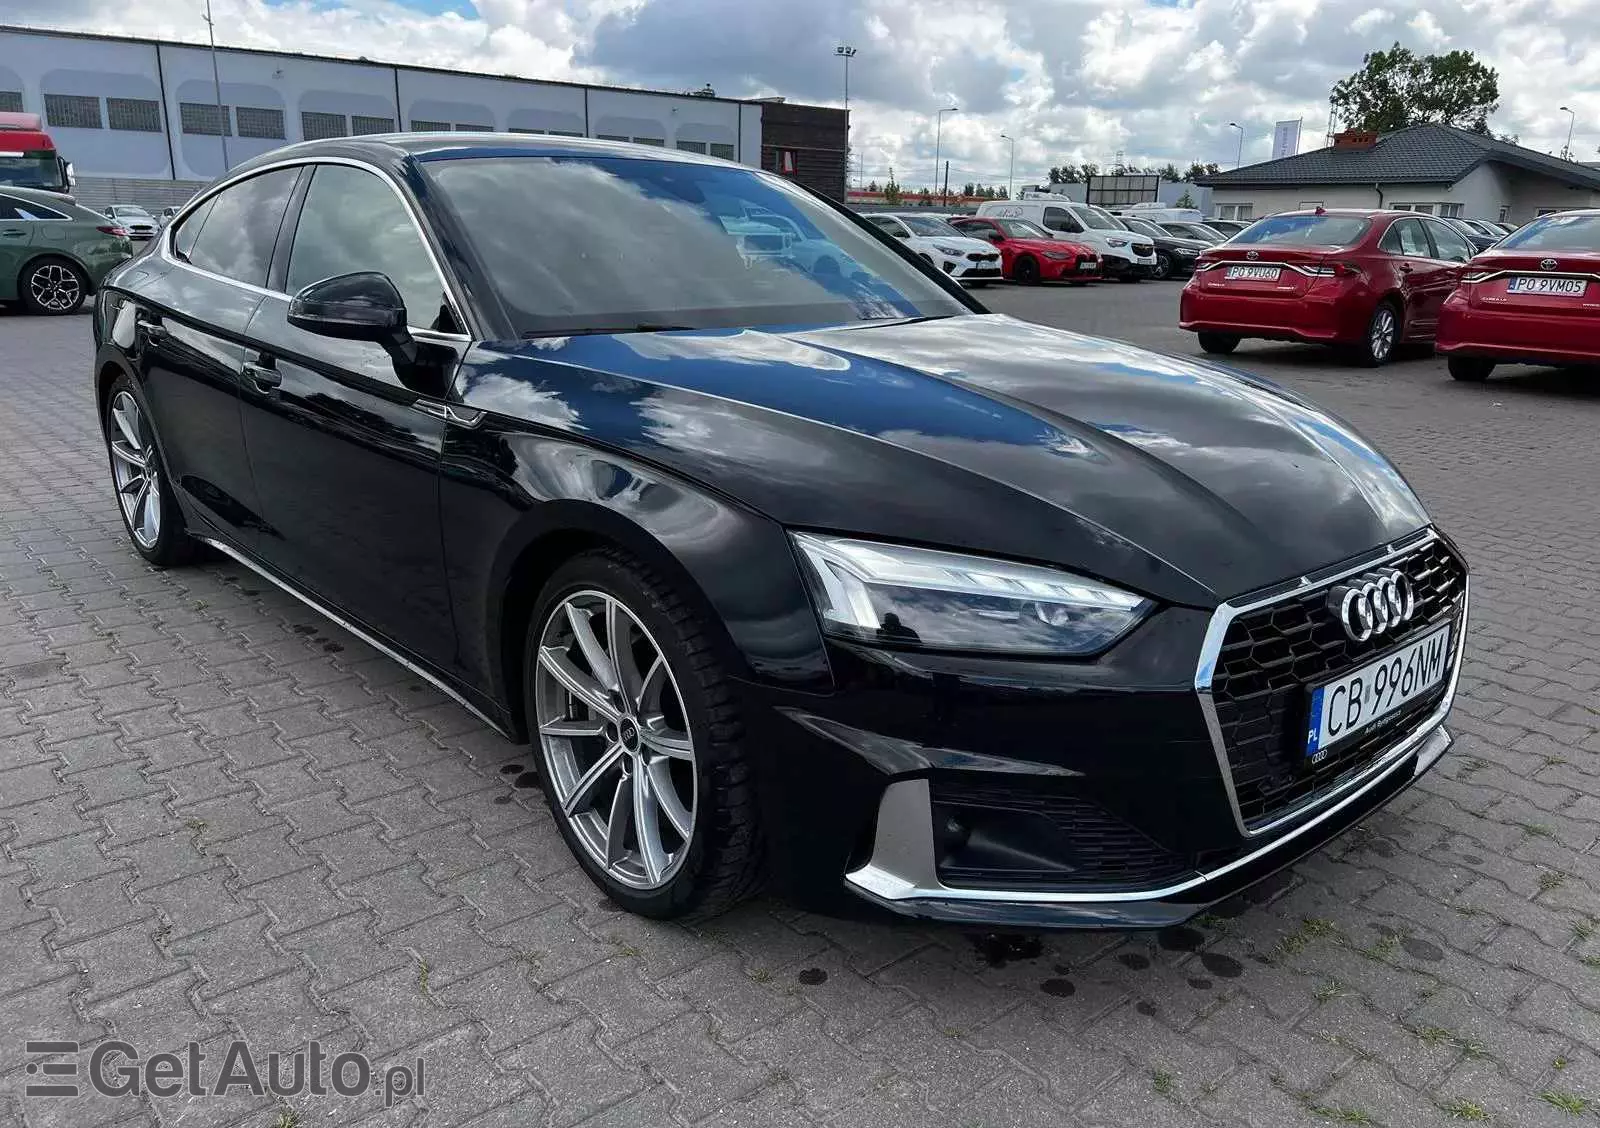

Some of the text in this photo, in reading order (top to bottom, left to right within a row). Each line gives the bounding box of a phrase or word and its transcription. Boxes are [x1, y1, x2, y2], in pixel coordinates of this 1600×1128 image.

[1232, 266, 1278, 277] PO 9VU60
[1517, 278, 1536, 291] PO
[1540, 279, 1582, 293] 9VM05
[1327, 633, 1444, 737] CB 996NM
[1307, 727, 1318, 745] PL
